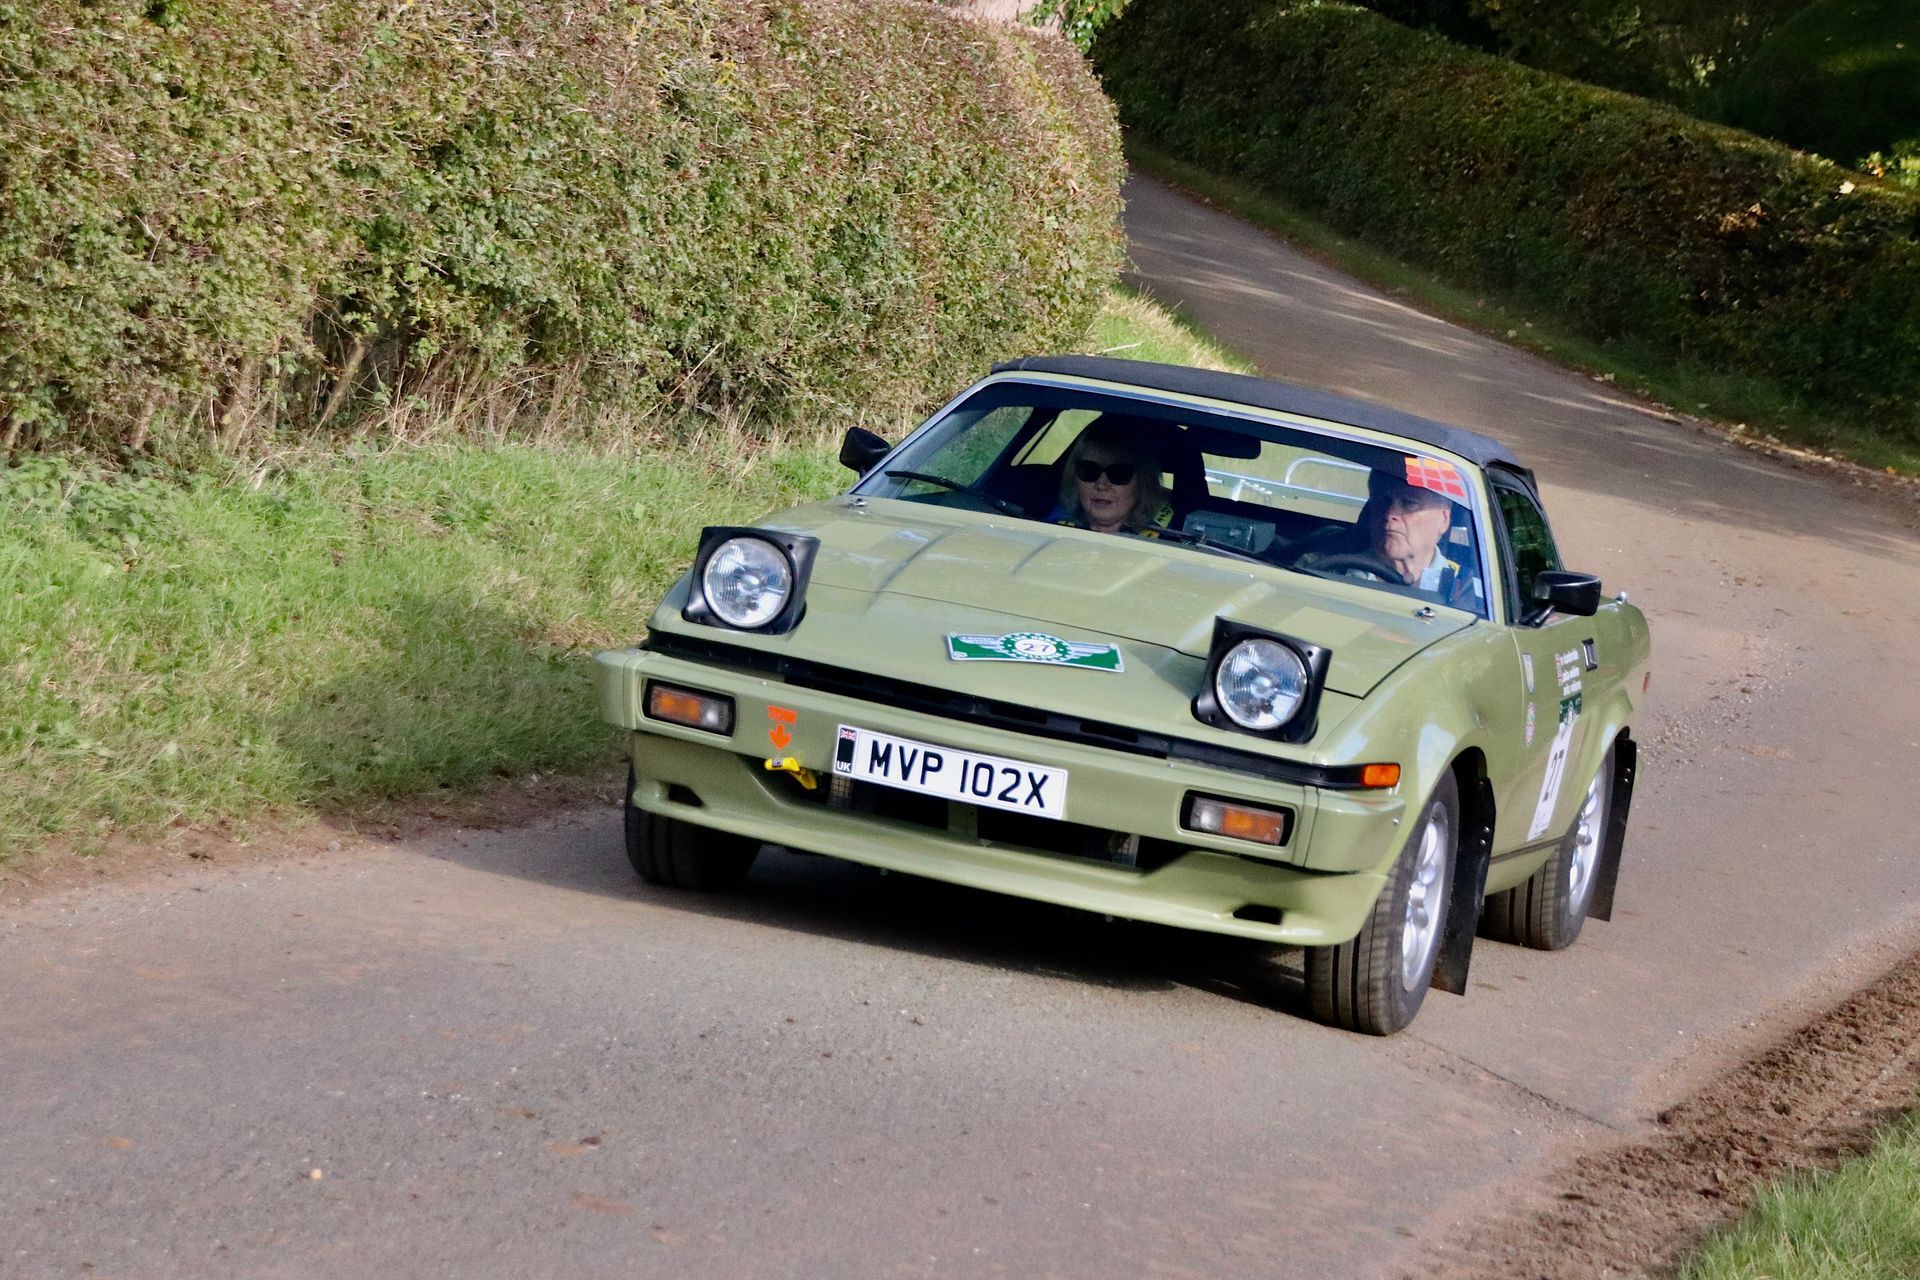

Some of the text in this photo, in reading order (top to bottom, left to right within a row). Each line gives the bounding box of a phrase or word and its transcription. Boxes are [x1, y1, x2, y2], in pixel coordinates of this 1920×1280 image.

[1023, 642, 1050, 653] 27
[836, 760, 851, 772] UK
[868, 739, 1049, 809] MVP 102X
